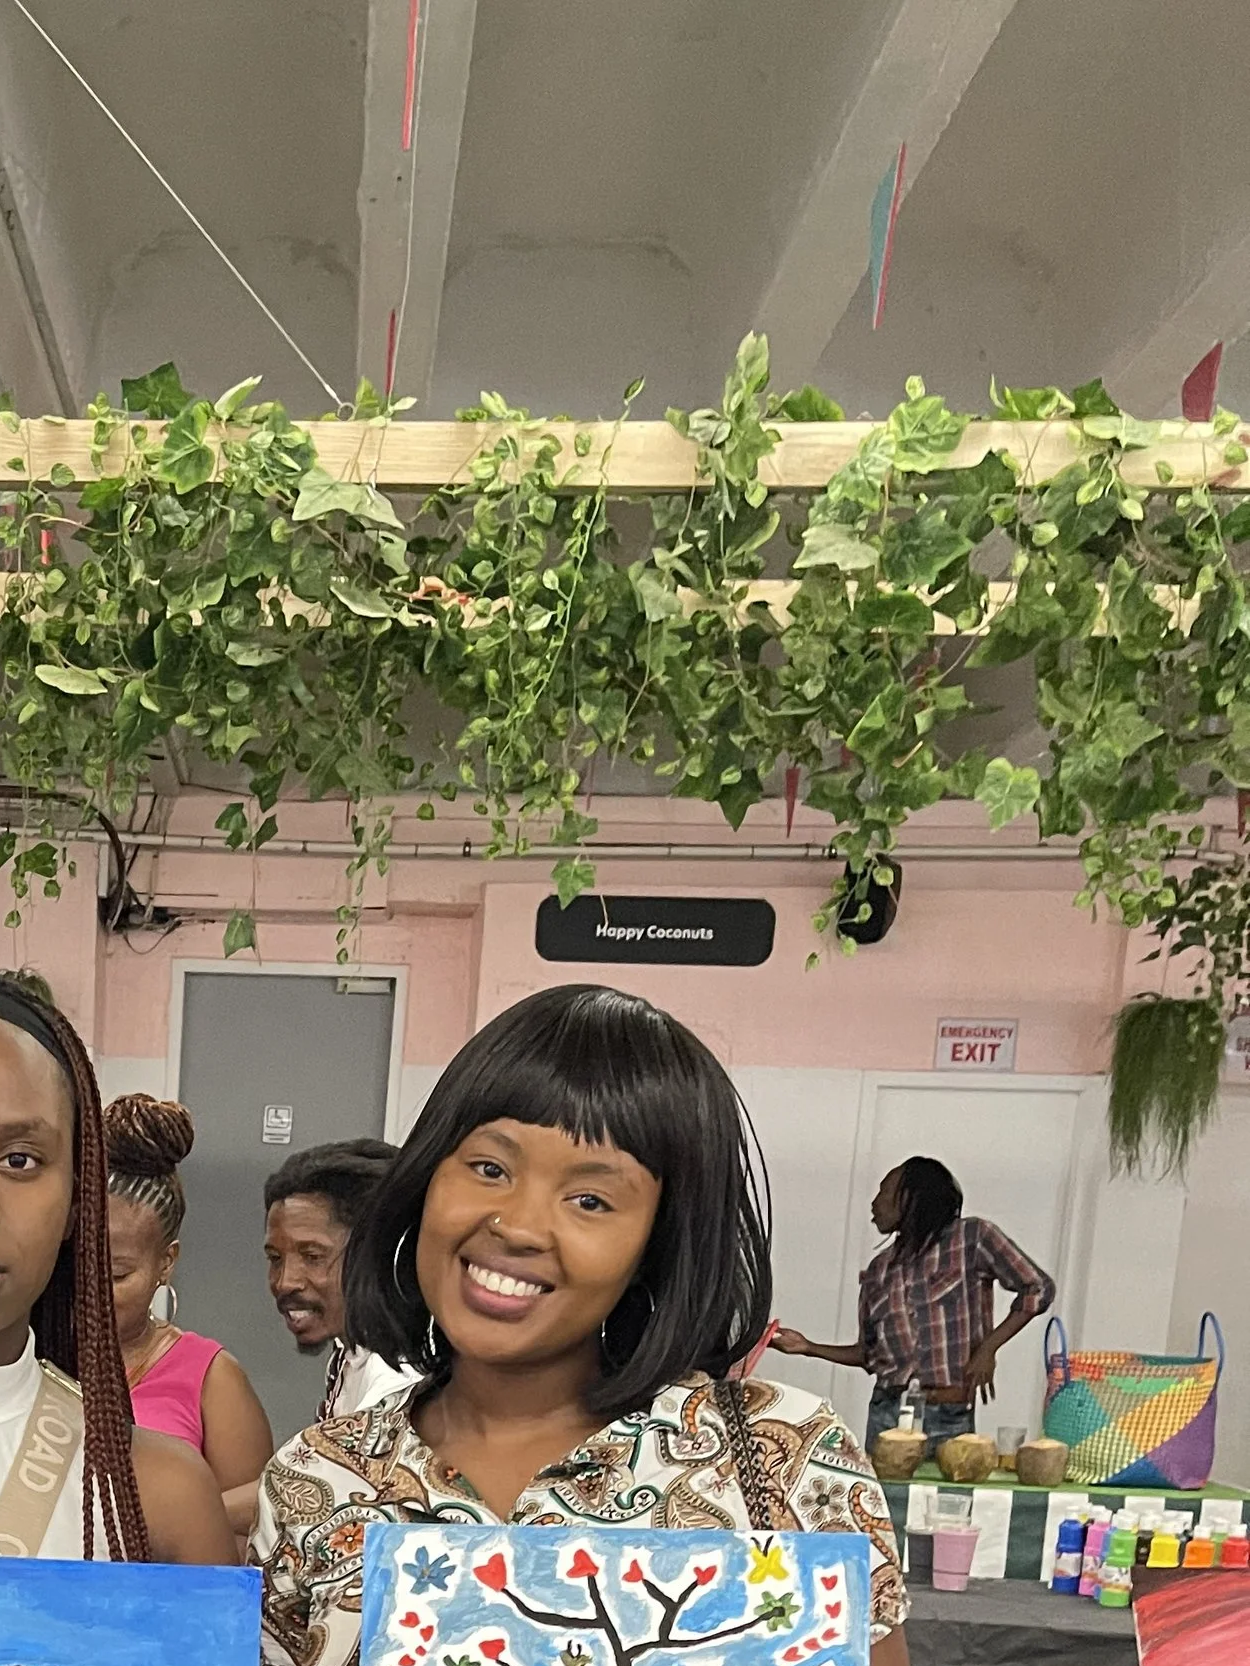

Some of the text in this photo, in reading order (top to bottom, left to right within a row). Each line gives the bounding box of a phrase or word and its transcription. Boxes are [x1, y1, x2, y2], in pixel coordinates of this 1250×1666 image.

[595, 923, 714, 941] Happy Coconuts
[940, 1026, 1014, 1039] EMERGENCY
[951, 1042, 1002, 1062] EXIT
